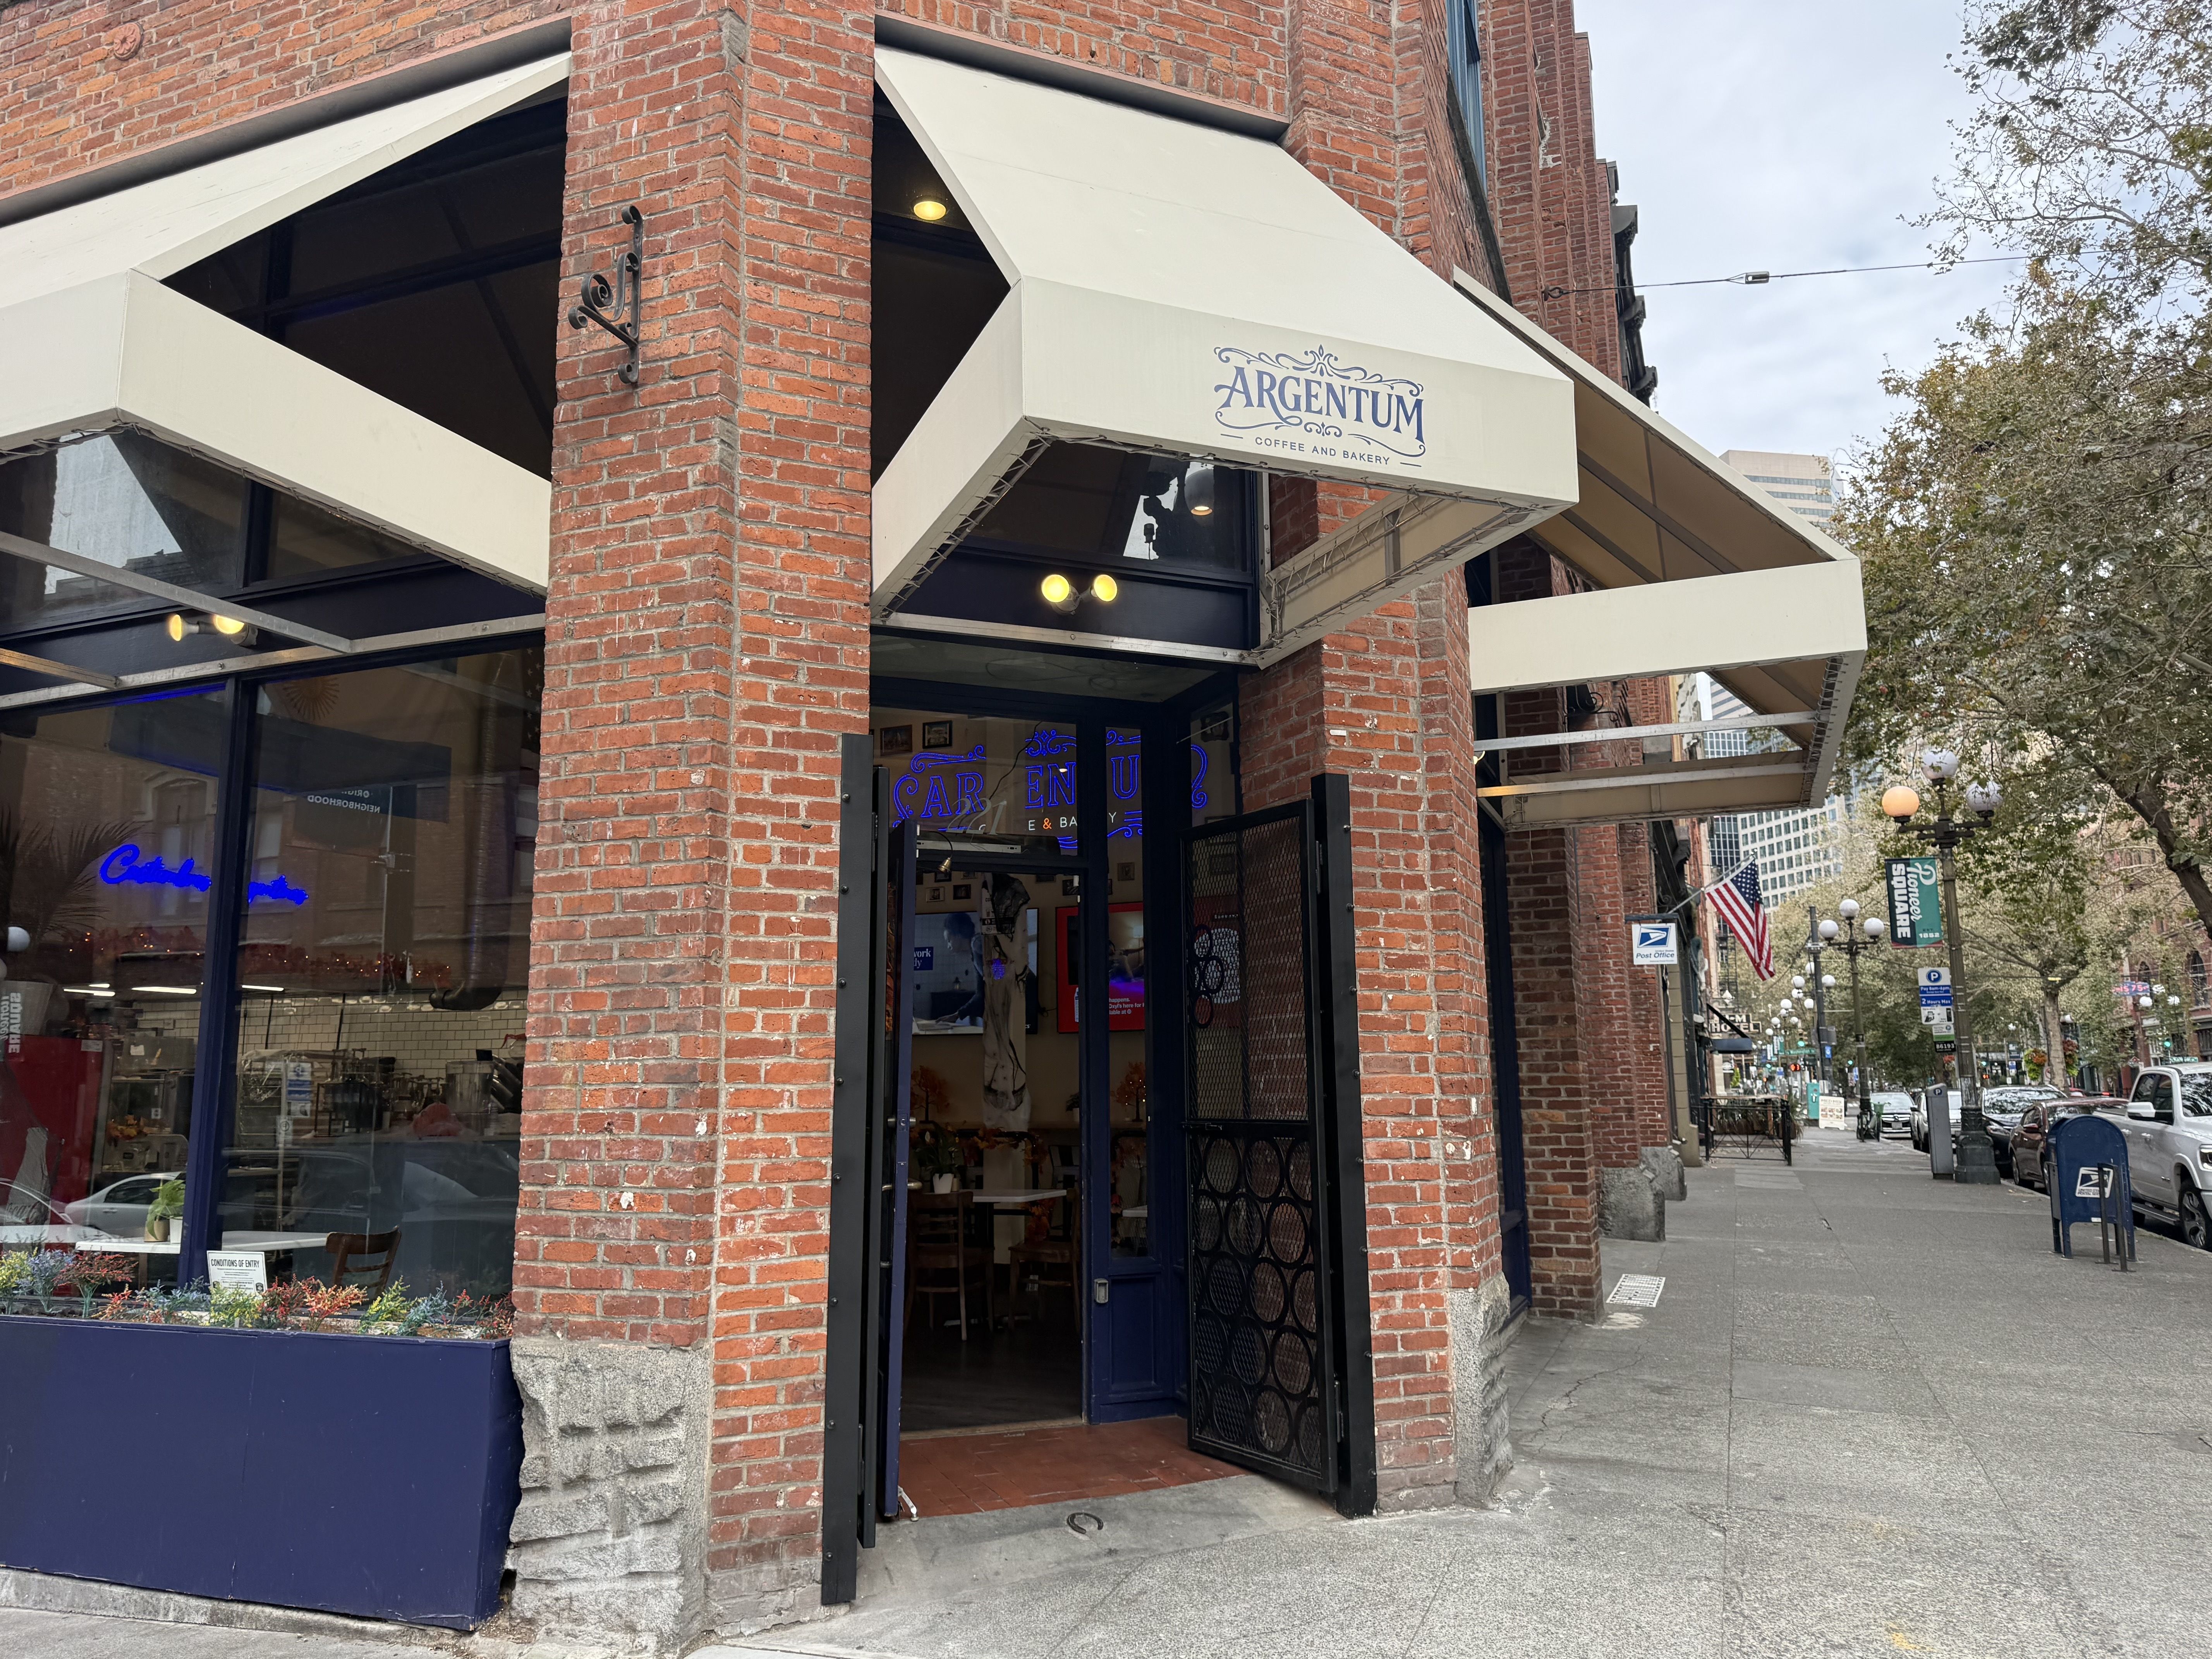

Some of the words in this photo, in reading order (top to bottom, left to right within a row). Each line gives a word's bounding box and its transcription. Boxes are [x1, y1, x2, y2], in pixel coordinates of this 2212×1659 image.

[1214, 366, 1425, 444] ARGENTUM
[1255, 437, 1304, 452] COFFEE
[1312, 446, 1336, 456] AND
[1343, 450, 1390, 465] BAKERY
[946, 797, 1007, 835] 221
[1891, 864, 1911, 938] SQUARE
[1906, 862, 1936, 922] Pioneer
[211, 1259, 237, 1267] CONDITIONS
